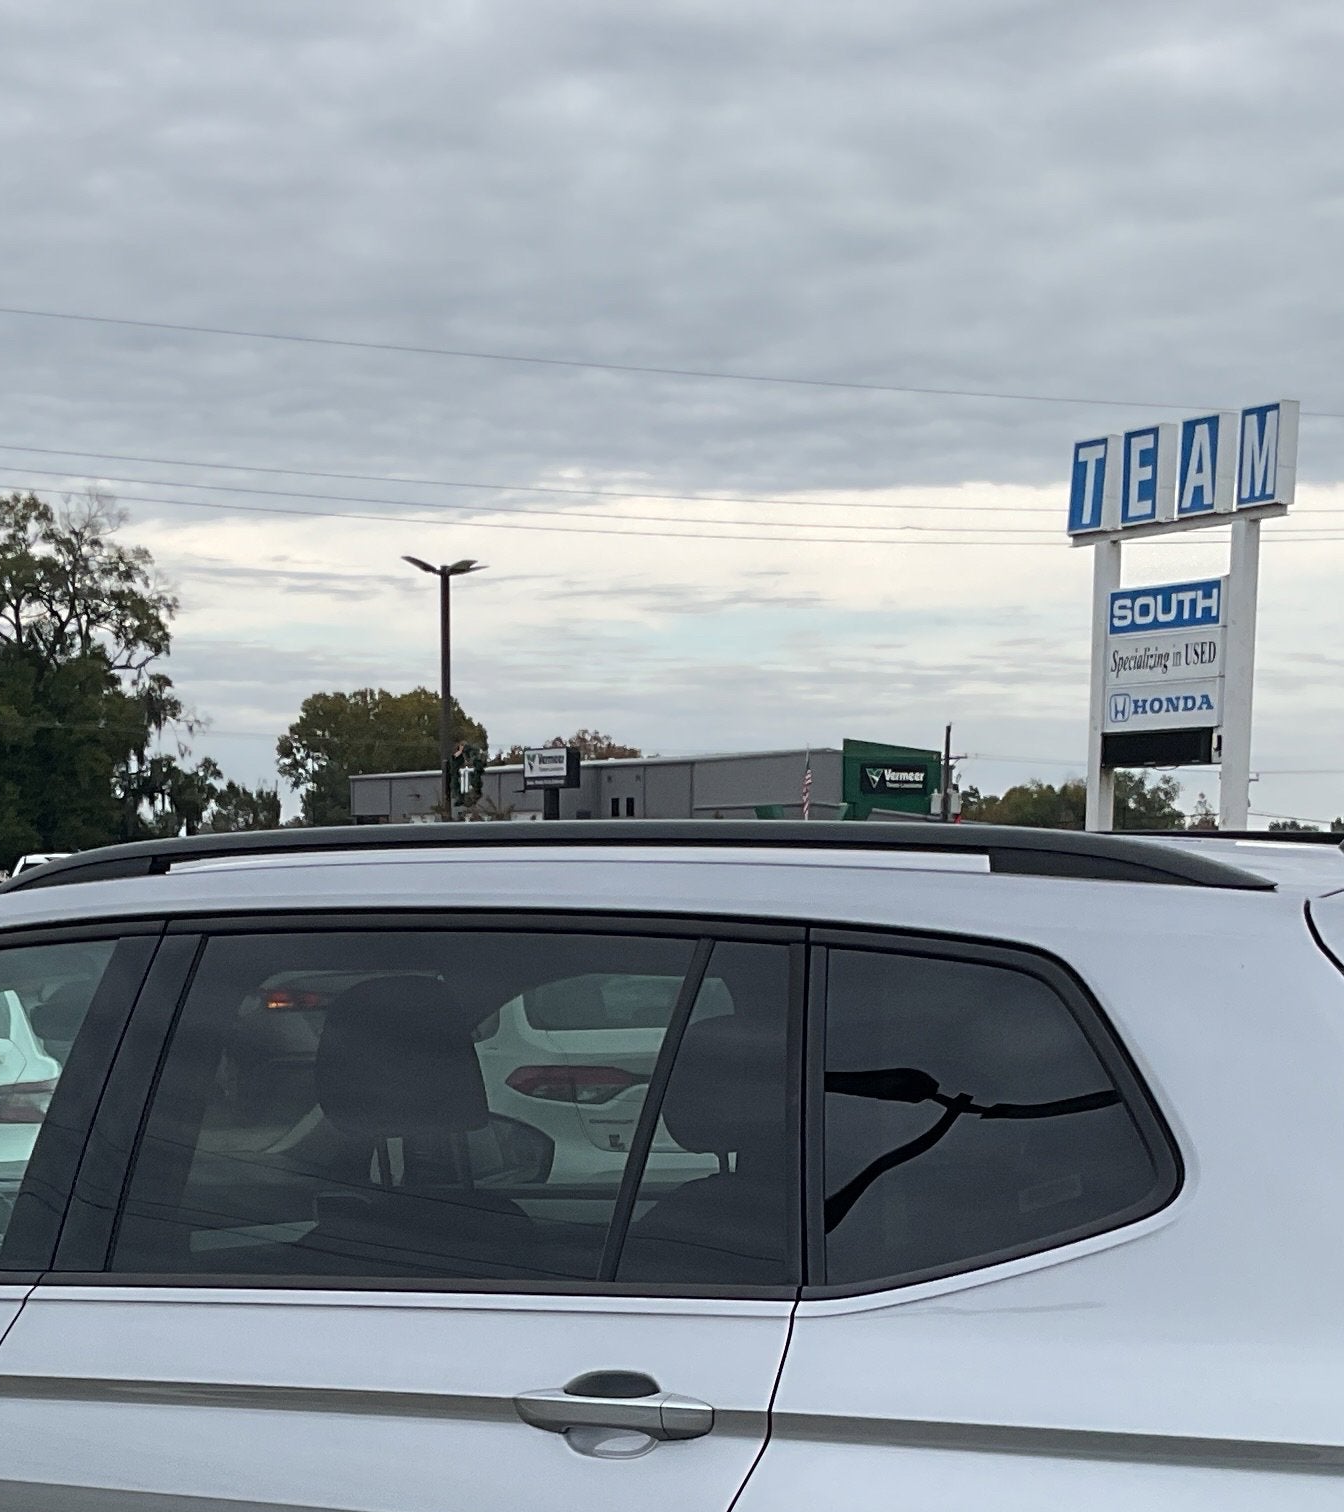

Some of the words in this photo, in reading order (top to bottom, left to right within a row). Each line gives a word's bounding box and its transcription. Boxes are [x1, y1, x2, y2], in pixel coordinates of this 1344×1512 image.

[1077, 410, 1279, 525] TEAM
[1112, 588, 1218, 627] SOUTH
[1110, 646, 1170, 679] Specializing
[1184, 641, 1217, 666] USED
[1131, 694, 1214, 716] HONDA
[884, 769, 925, 782] Vermeer
